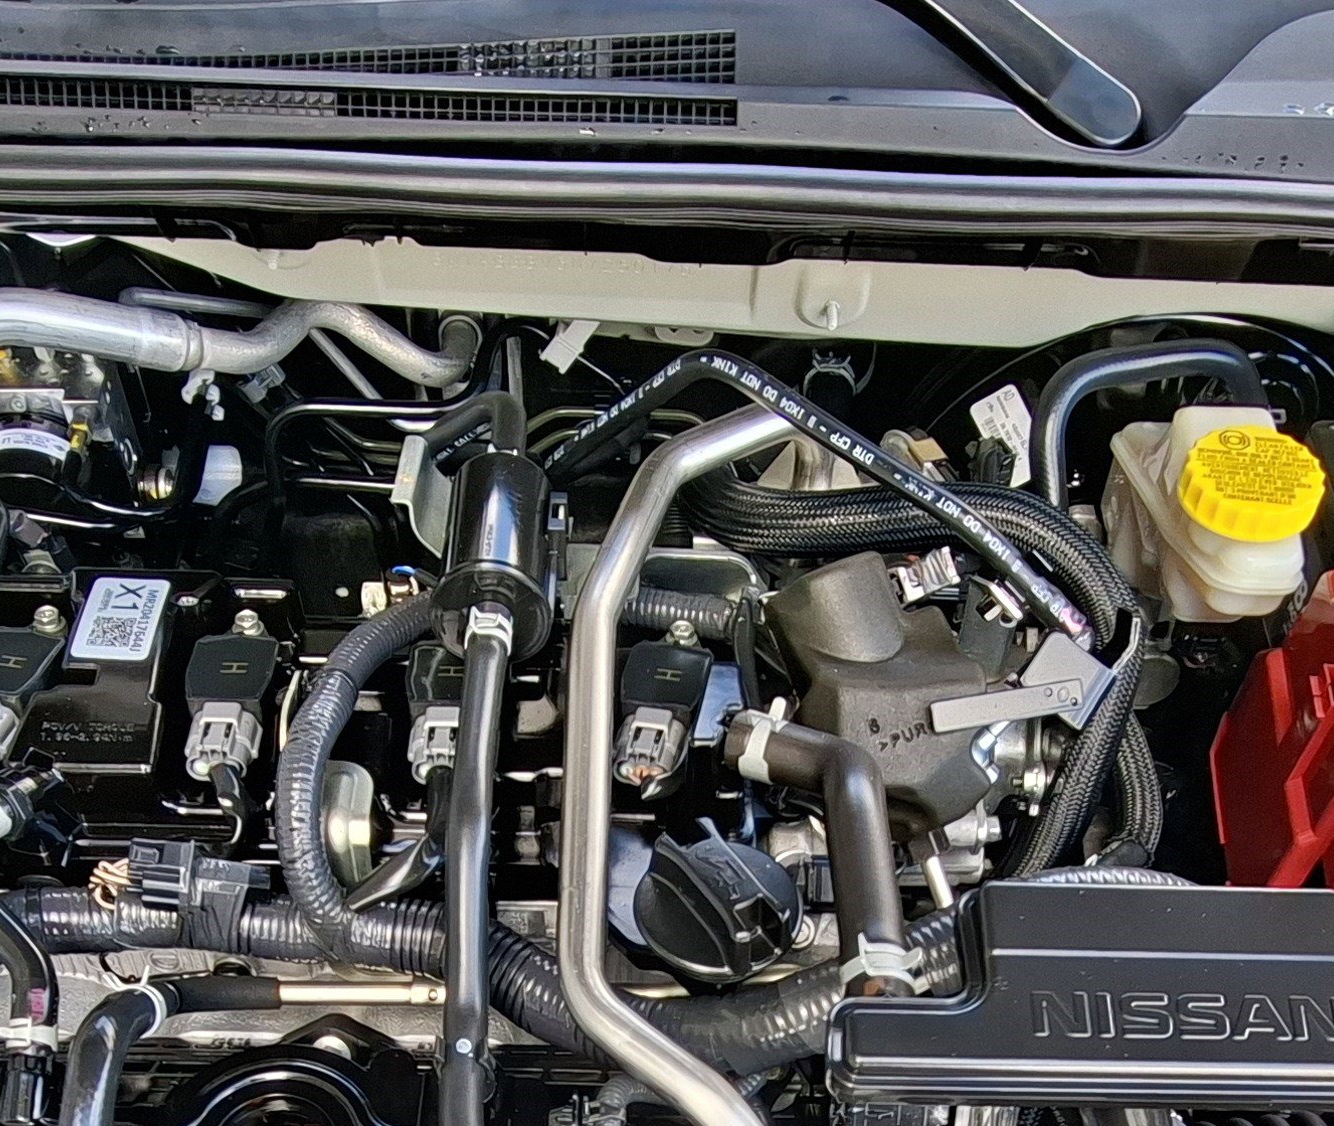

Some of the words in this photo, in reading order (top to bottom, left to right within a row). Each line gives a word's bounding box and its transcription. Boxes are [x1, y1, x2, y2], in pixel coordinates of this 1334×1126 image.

[711, 355, 739, 377] KINK
[740, 371, 763, 391] NOT
[763, 384, 779, 402] DO
[830, 431, 851, 450] CFP
[853, 447, 874, 466] DTR
[961, 515, 981, 533] DO
[111, 583, 146, 610] X1
